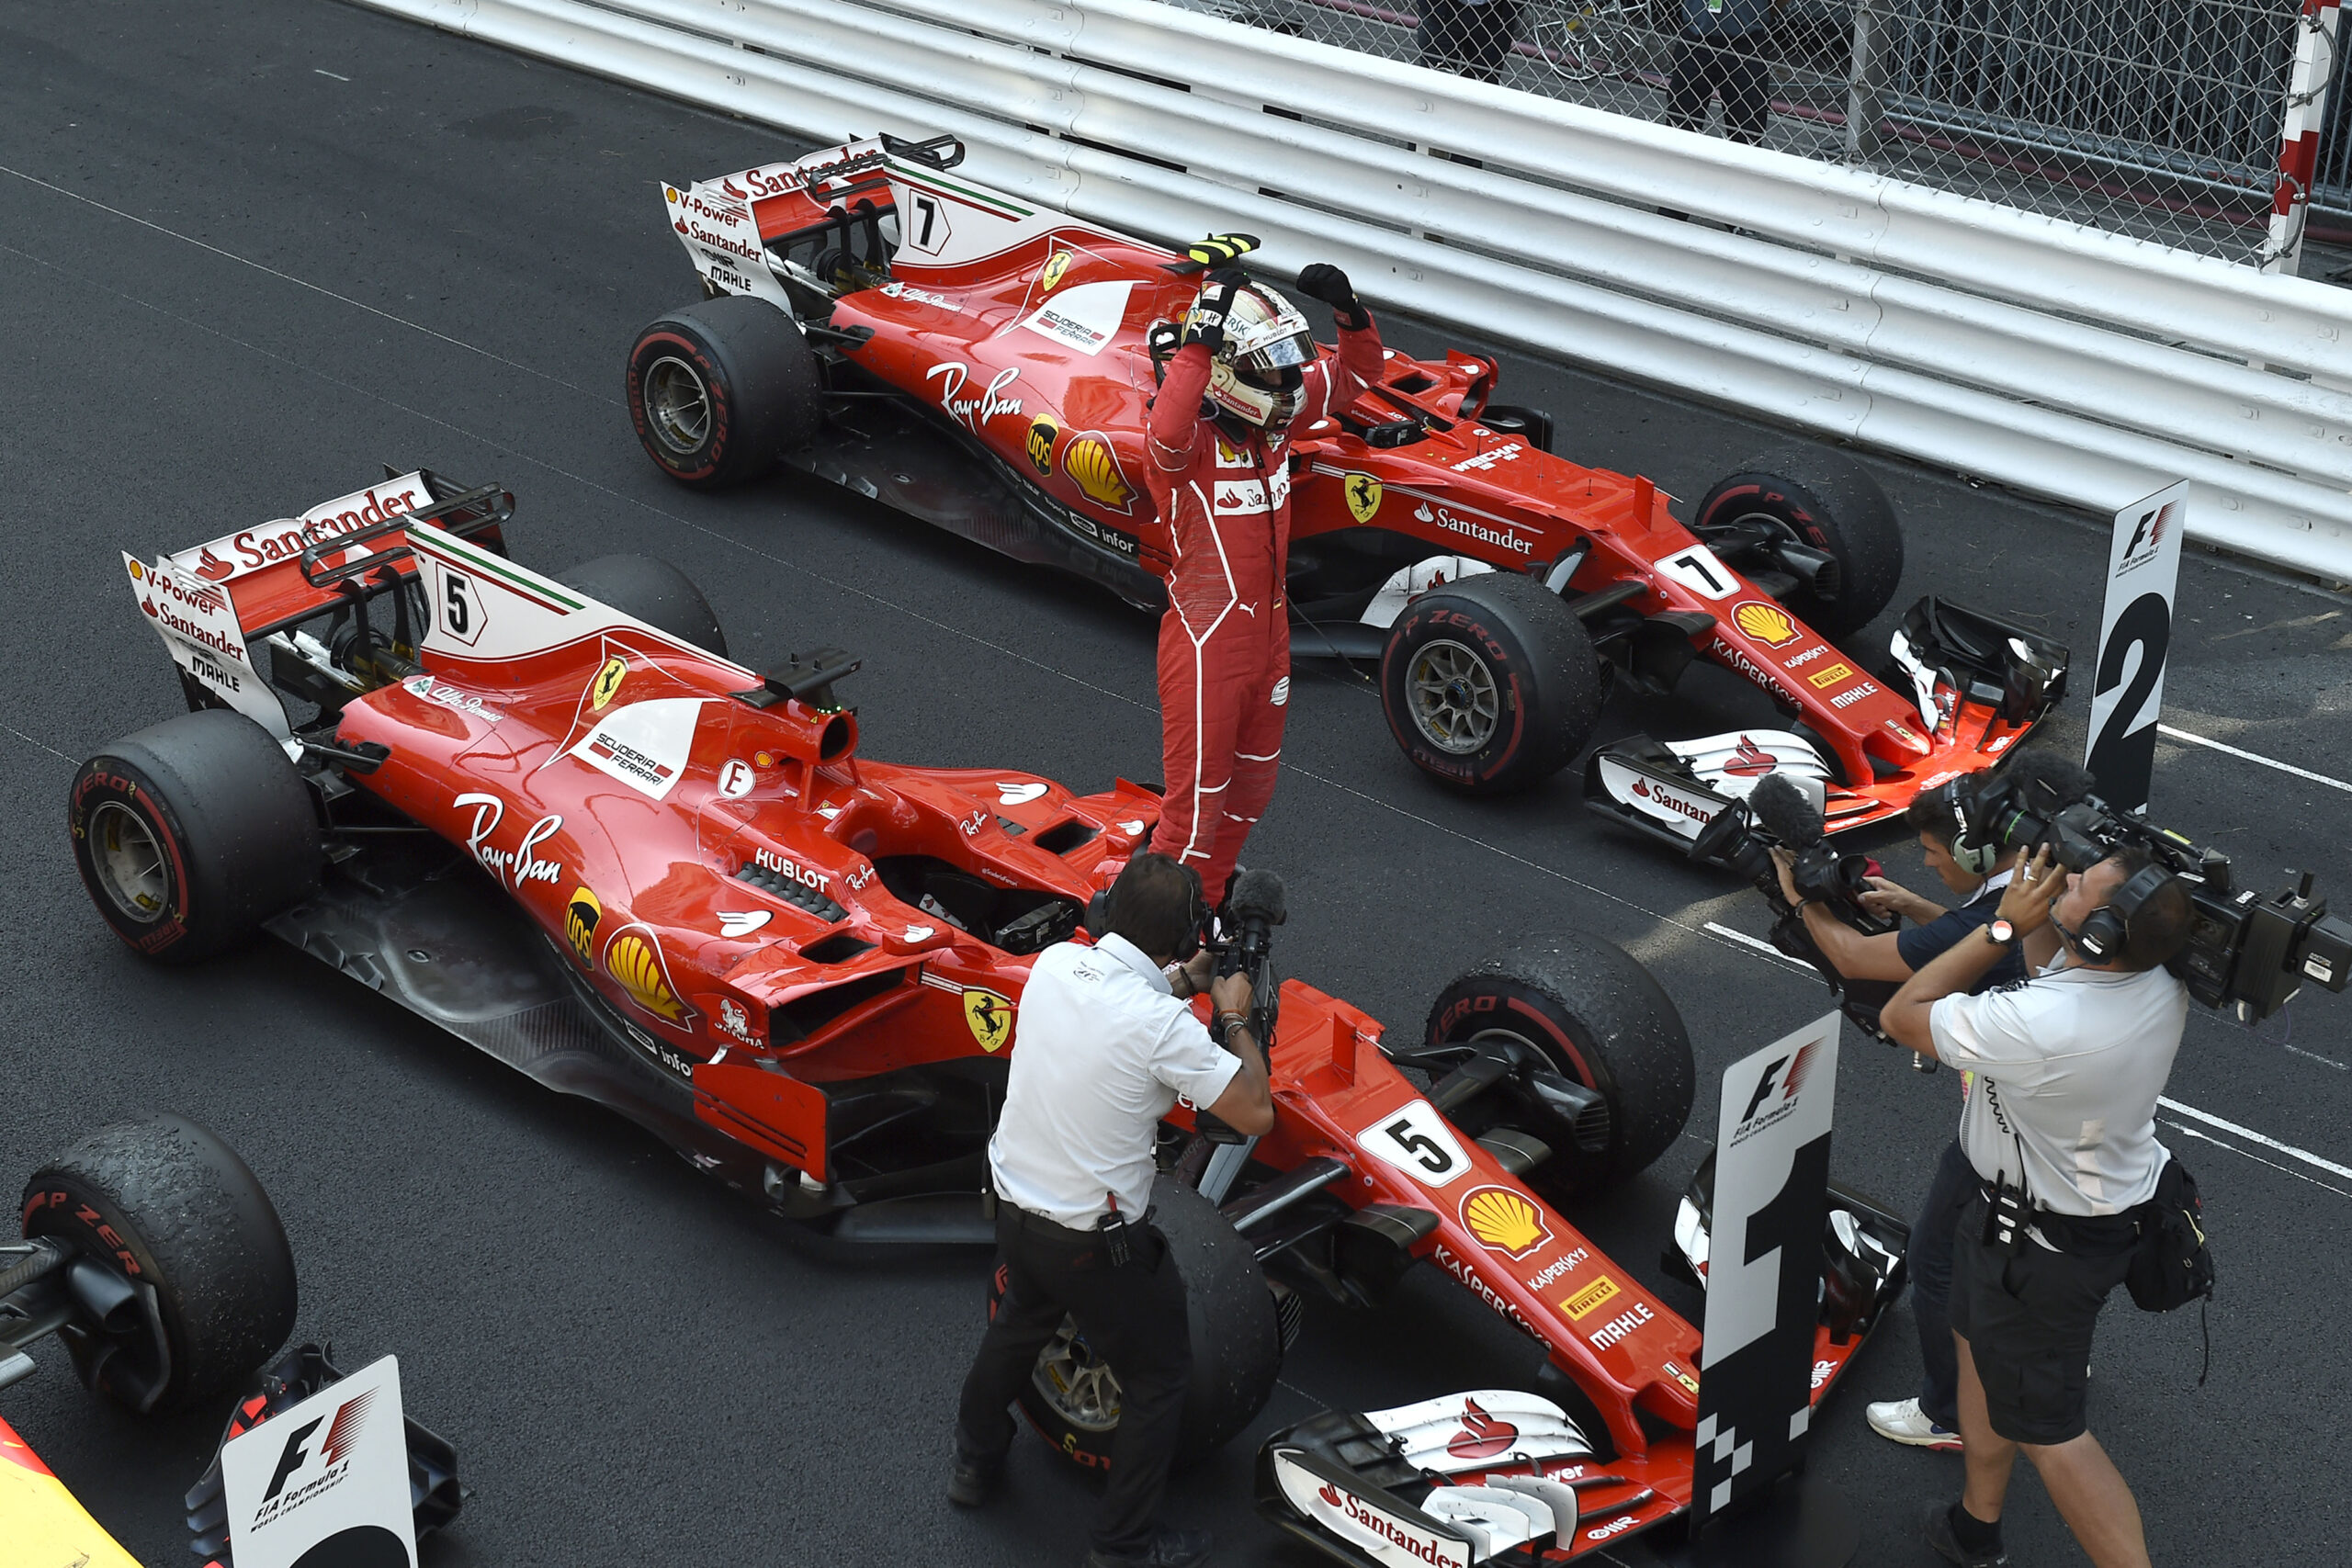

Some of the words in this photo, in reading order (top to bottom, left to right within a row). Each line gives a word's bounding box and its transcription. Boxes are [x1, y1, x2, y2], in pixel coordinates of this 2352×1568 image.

[679, 192, 740, 229] V-Power
[917, 196, 934, 247] 7
[690, 221, 762, 264] Santander
[711, 265, 752, 292] MAHLE
[1044, 310, 1092, 337] SCUDERIA
[1054, 323, 1098, 347] FERRARI
[709, 381, 728, 462] ZERO
[1222, 393, 1259, 418] Santander
[1027, 428, 1051, 468] ups
[1450, 443, 1523, 472] WEICHAI
[234, 490, 417, 569] Santander
[1102, 529, 1135, 553] infor
[1437, 508, 1533, 555] Santander
[144, 569, 220, 618] V-Power
[1675, 556, 1724, 592] 7
[446, 570, 469, 634] 5
[159, 603, 243, 663] Santander
[1429, 610, 1507, 660] ZERO
[192, 655, 241, 694] MAHLE
[1814, 666, 1848, 686] PIRELLI
[2084, 592, 2170, 781] 2
[459, 697, 504, 723] Romeo
[1830, 682, 1879, 709] MAHLE
[596, 732, 658, 771] SCUDERIA
[611, 753, 665, 787] FERRARI
[1652, 785, 1714, 824] Santan
[754, 847, 830, 895] HUBLOT
[566, 906, 591, 961] ups
[660, 1045, 693, 1077] info
[1741, 1035, 1828, 1124] F1
[1385, 1118, 1453, 1174] 5
[51, 1192, 67, 1209] P
[75, 1203, 143, 1277] ZER
[1527, 1248, 1584, 1292] KASPERSKY
[1566, 1281, 1613, 1315] PIRELLI
[1589, 1302, 1656, 1352] MAHLE
[262, 1384, 382, 1505] F1
[254, 1498, 280, 1522] FIA
[283, 1467, 339, 1506] Formula
[341, 1459, 350, 1473] 1
[251, 1513, 279, 1534] WORLD
